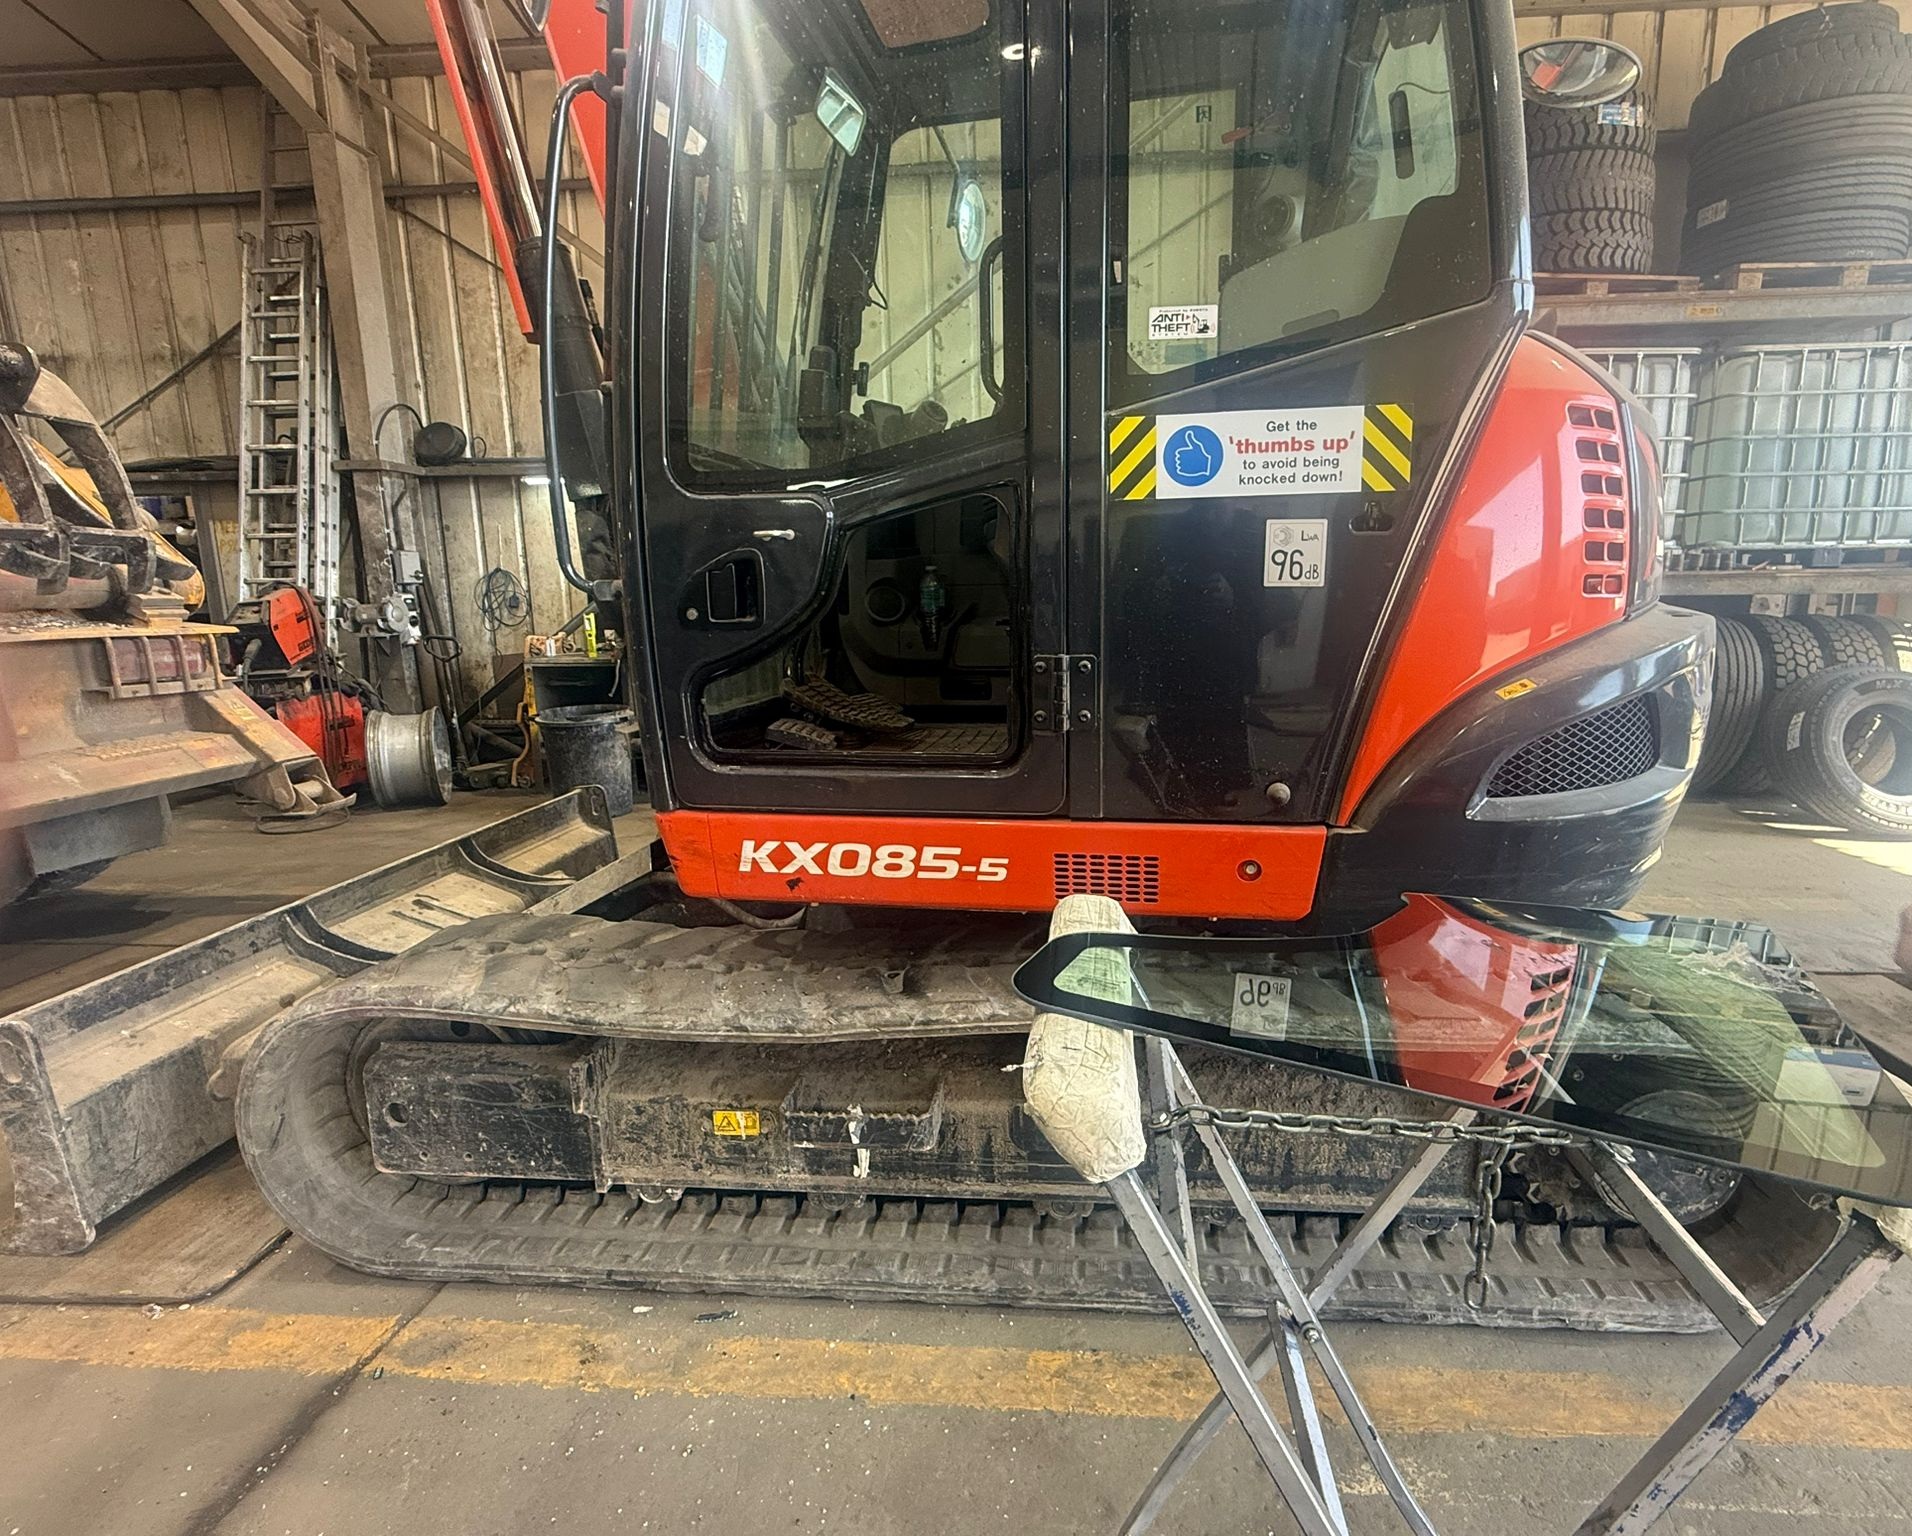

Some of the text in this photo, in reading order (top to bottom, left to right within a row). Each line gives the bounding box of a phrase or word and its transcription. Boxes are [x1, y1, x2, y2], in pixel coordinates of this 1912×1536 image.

[1152, 313, 1185, 323] ANTI
[1151, 322, 1191, 333] THEFT
[1266, 419, 1317, 432] Get the
[1229, 430, 1355, 454] 'thumbs up'
[1243, 456, 1340, 470] to avoid being
[1239, 470, 1343, 485] knocked down!
[1271, 549, 1304, 581] 96
[738, 839, 1010, 882] KX085-5
